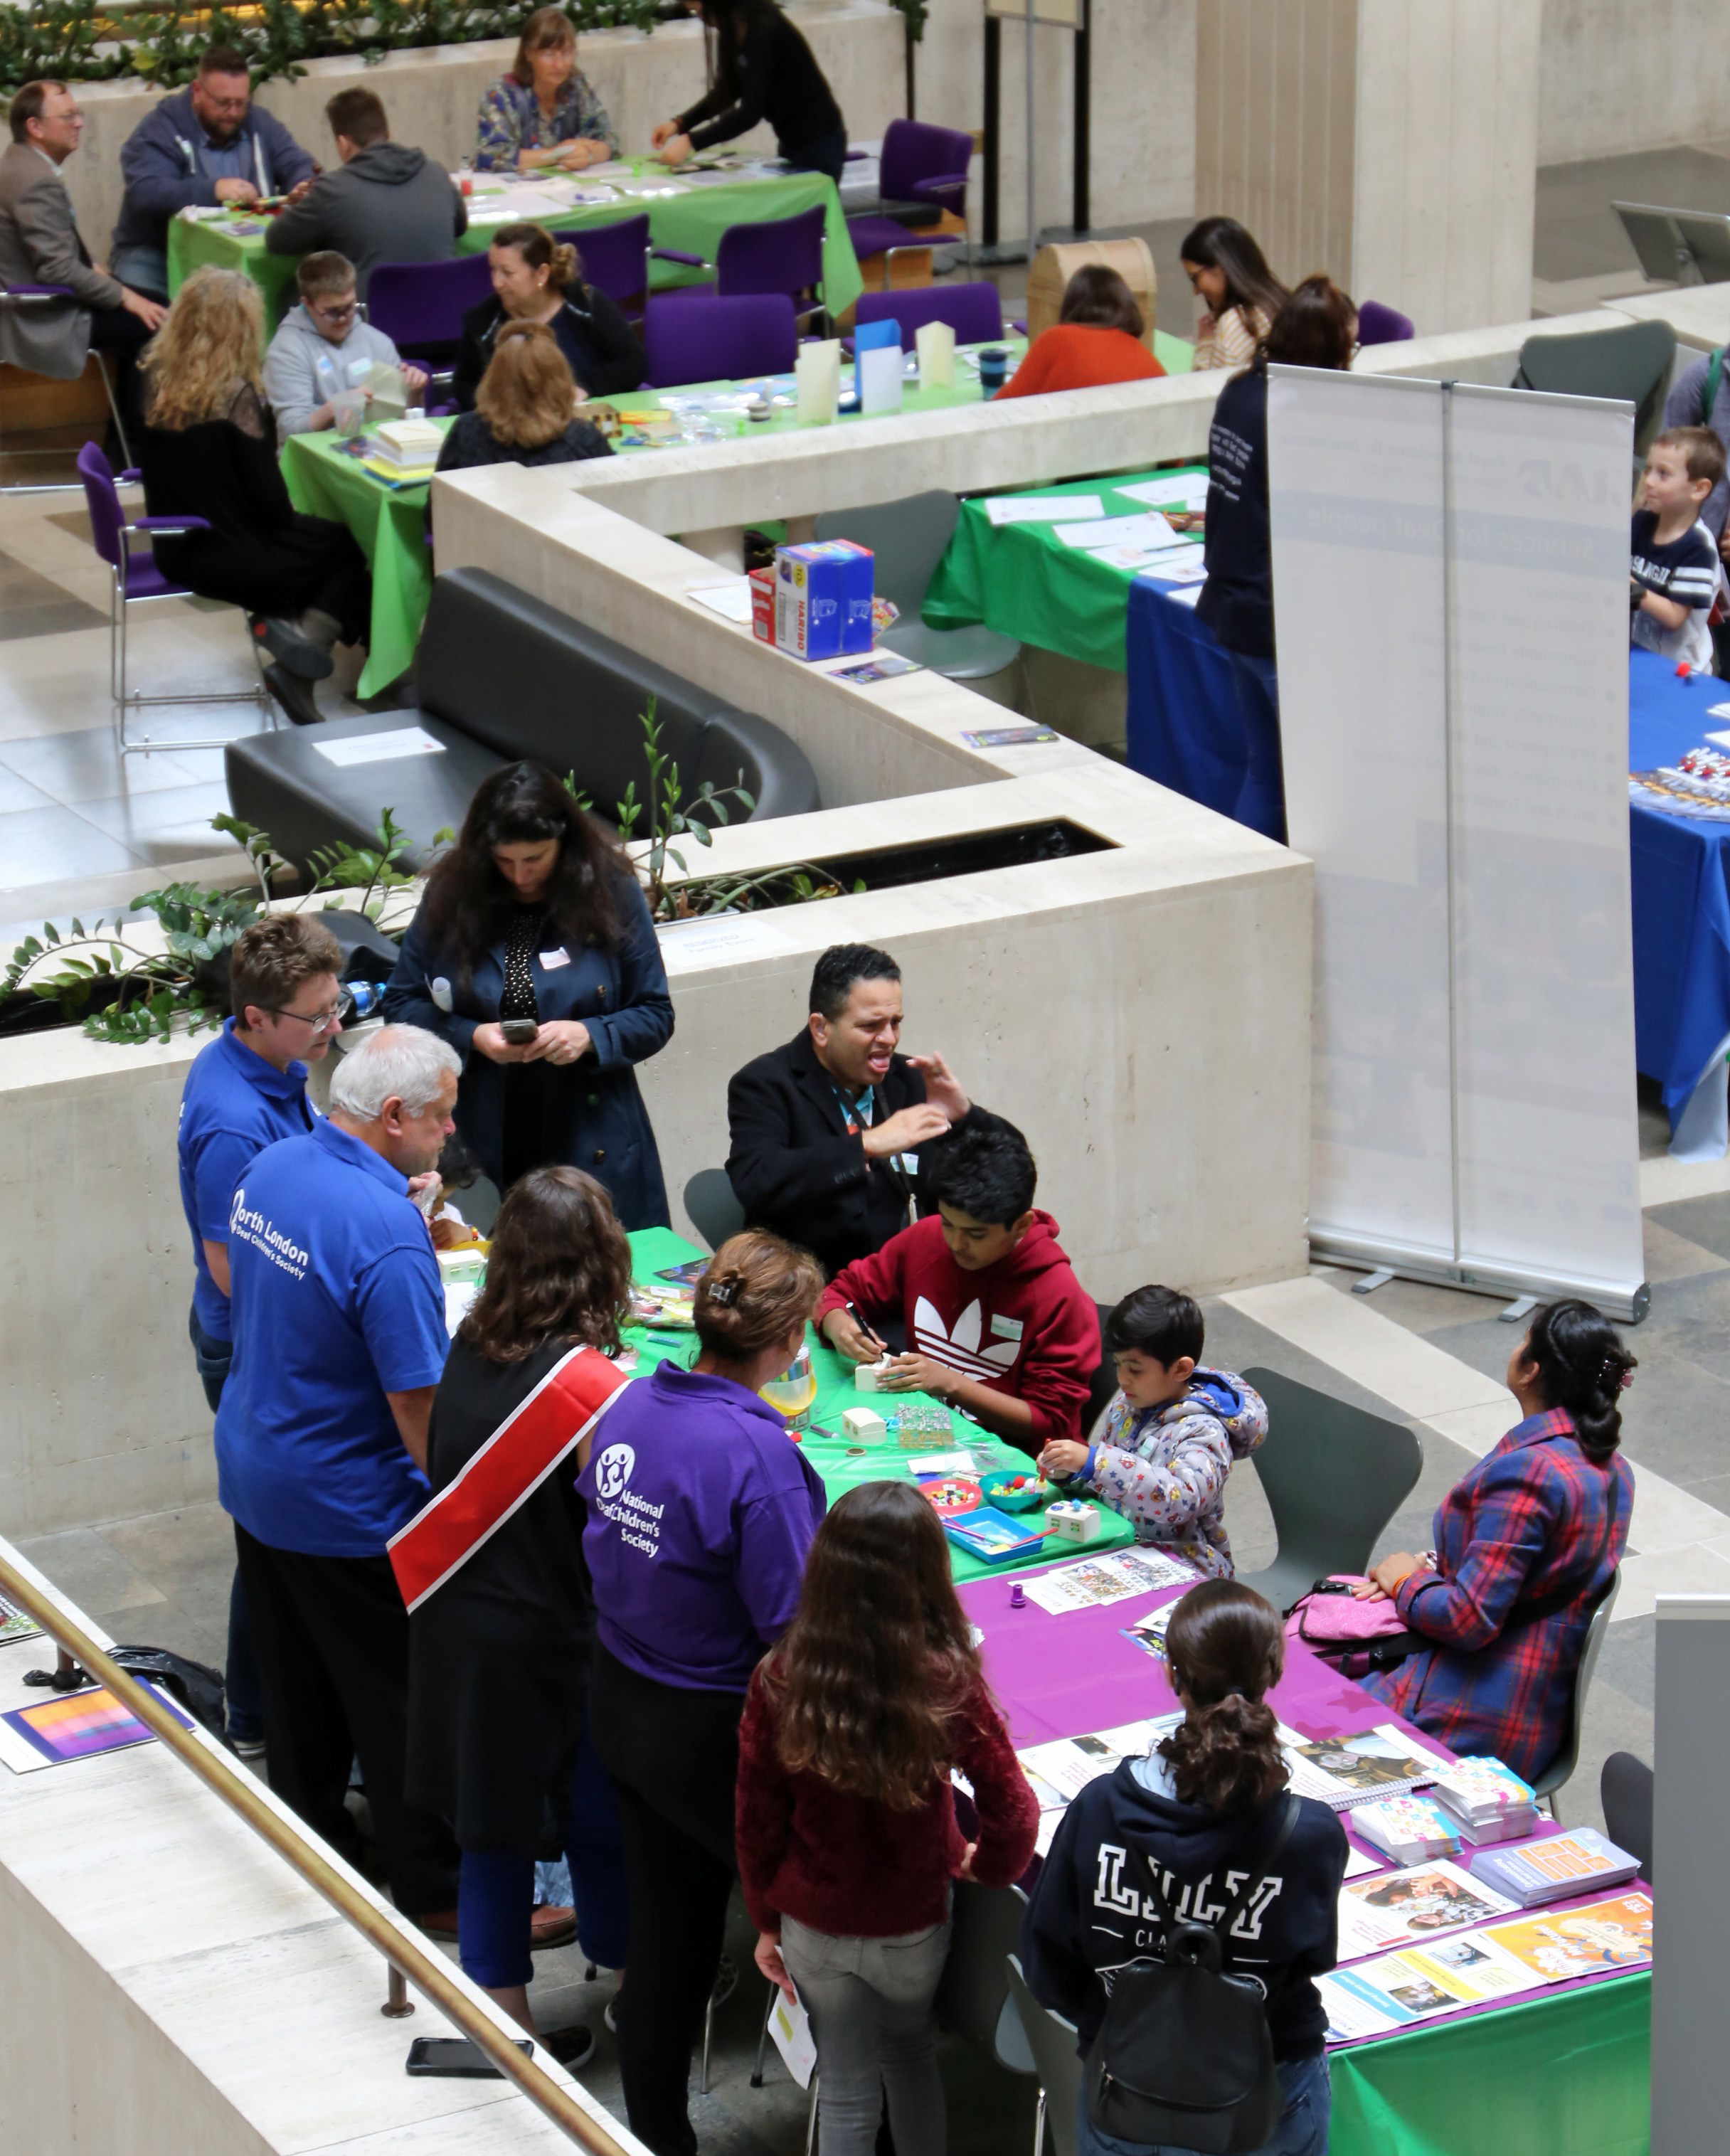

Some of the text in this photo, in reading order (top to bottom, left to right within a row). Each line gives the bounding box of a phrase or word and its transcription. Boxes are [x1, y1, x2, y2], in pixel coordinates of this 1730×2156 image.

[235, 1225, 306, 1281] Deaf Children's Society
[264, 1221, 309, 1266] London
[619, 1489, 665, 1519] National
[610, 1506, 660, 1538] Children's
[620, 1527, 659, 1558] Society
